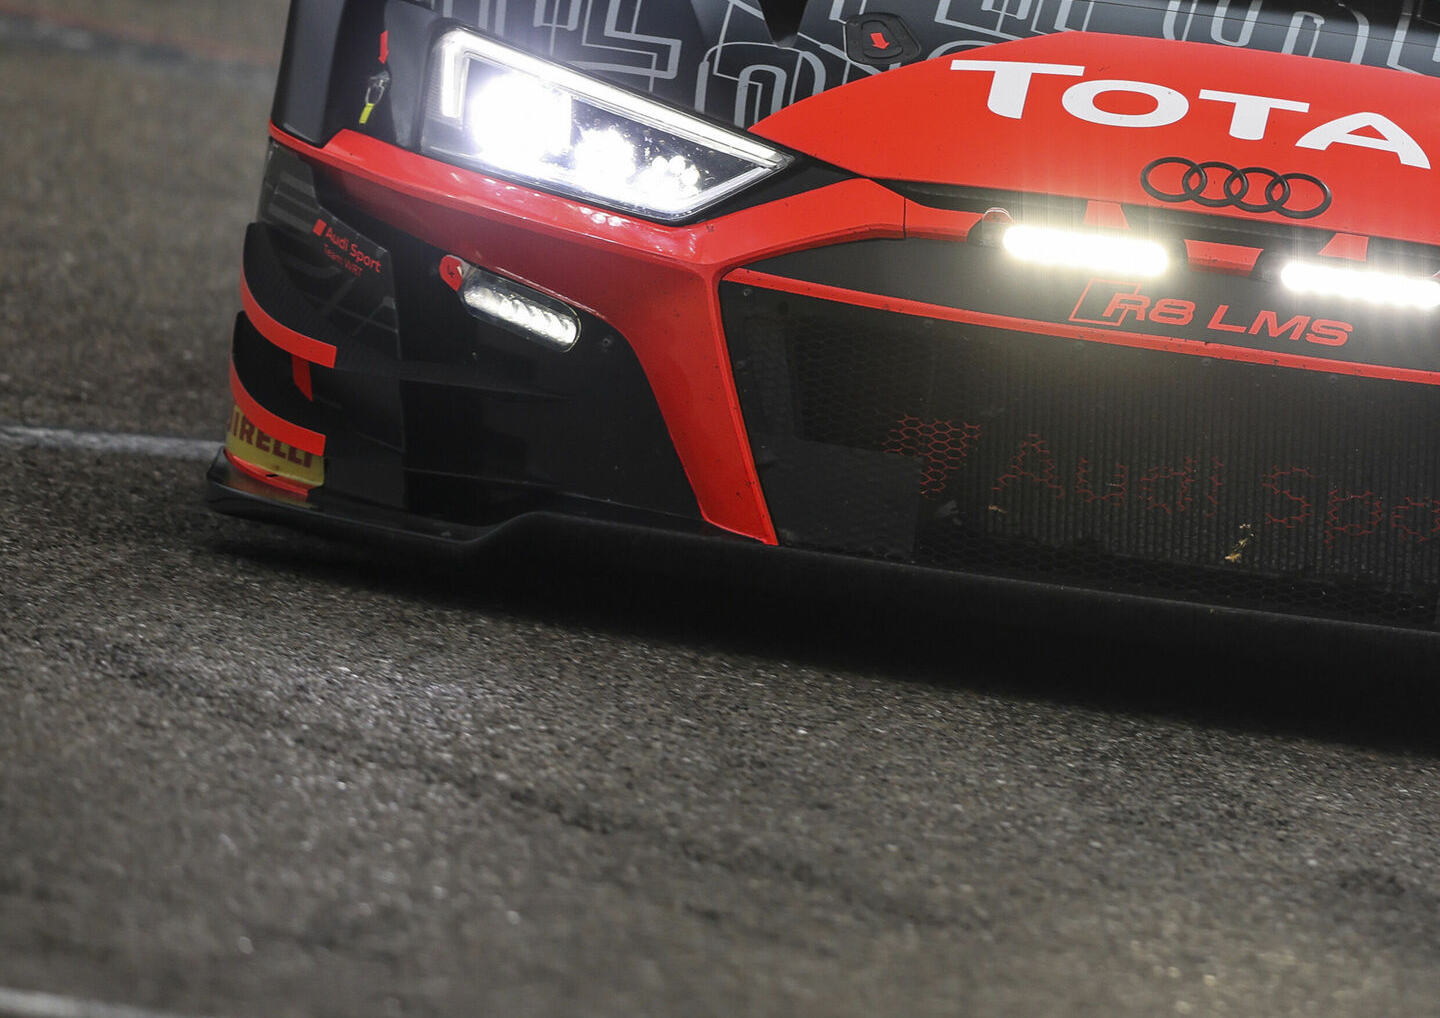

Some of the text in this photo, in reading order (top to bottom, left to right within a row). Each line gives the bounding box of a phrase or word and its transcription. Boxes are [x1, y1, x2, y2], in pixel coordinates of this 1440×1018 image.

[325, 226, 382, 273] Audi Sport
[1102, 292, 1354, 347] R8 LMS
